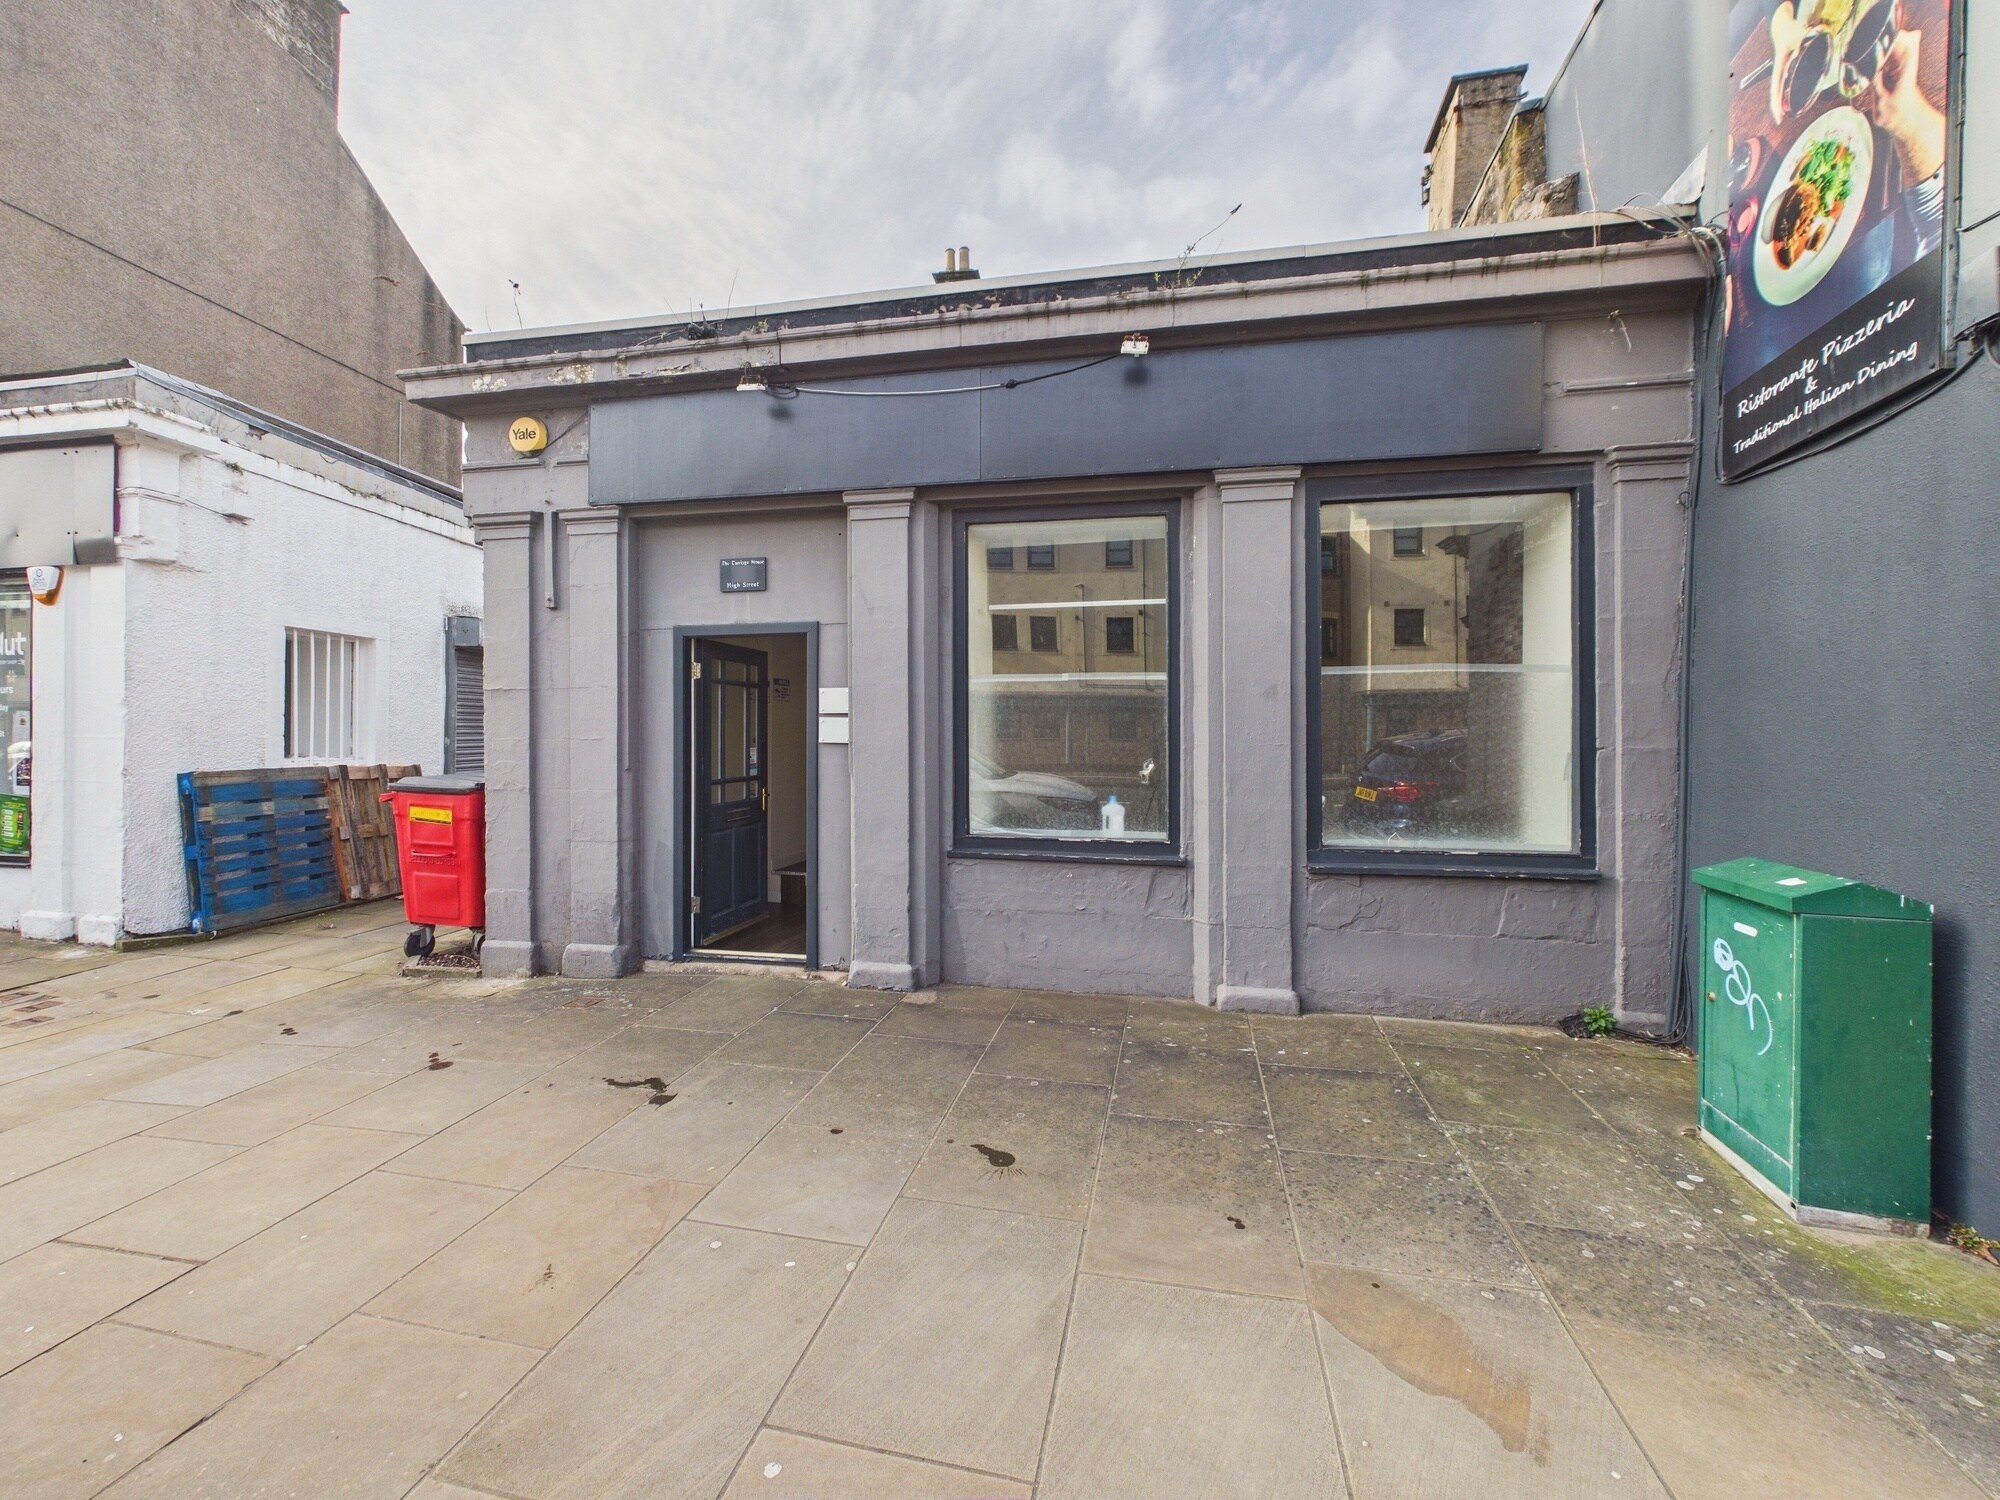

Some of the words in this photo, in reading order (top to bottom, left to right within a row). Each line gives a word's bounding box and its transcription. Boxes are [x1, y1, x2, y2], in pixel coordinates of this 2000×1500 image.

[1737, 358, 1819, 418] Ristorante
[1821, 298, 1916, 366] Pizzeria
[1804, 376, 1818, 395] &
[1732, 405, 1802, 454] Traditional
[1803, 379, 1856, 416] Italian
[1857, 341, 1918, 386] Dining
[512, 428, 537, 440] Yale
